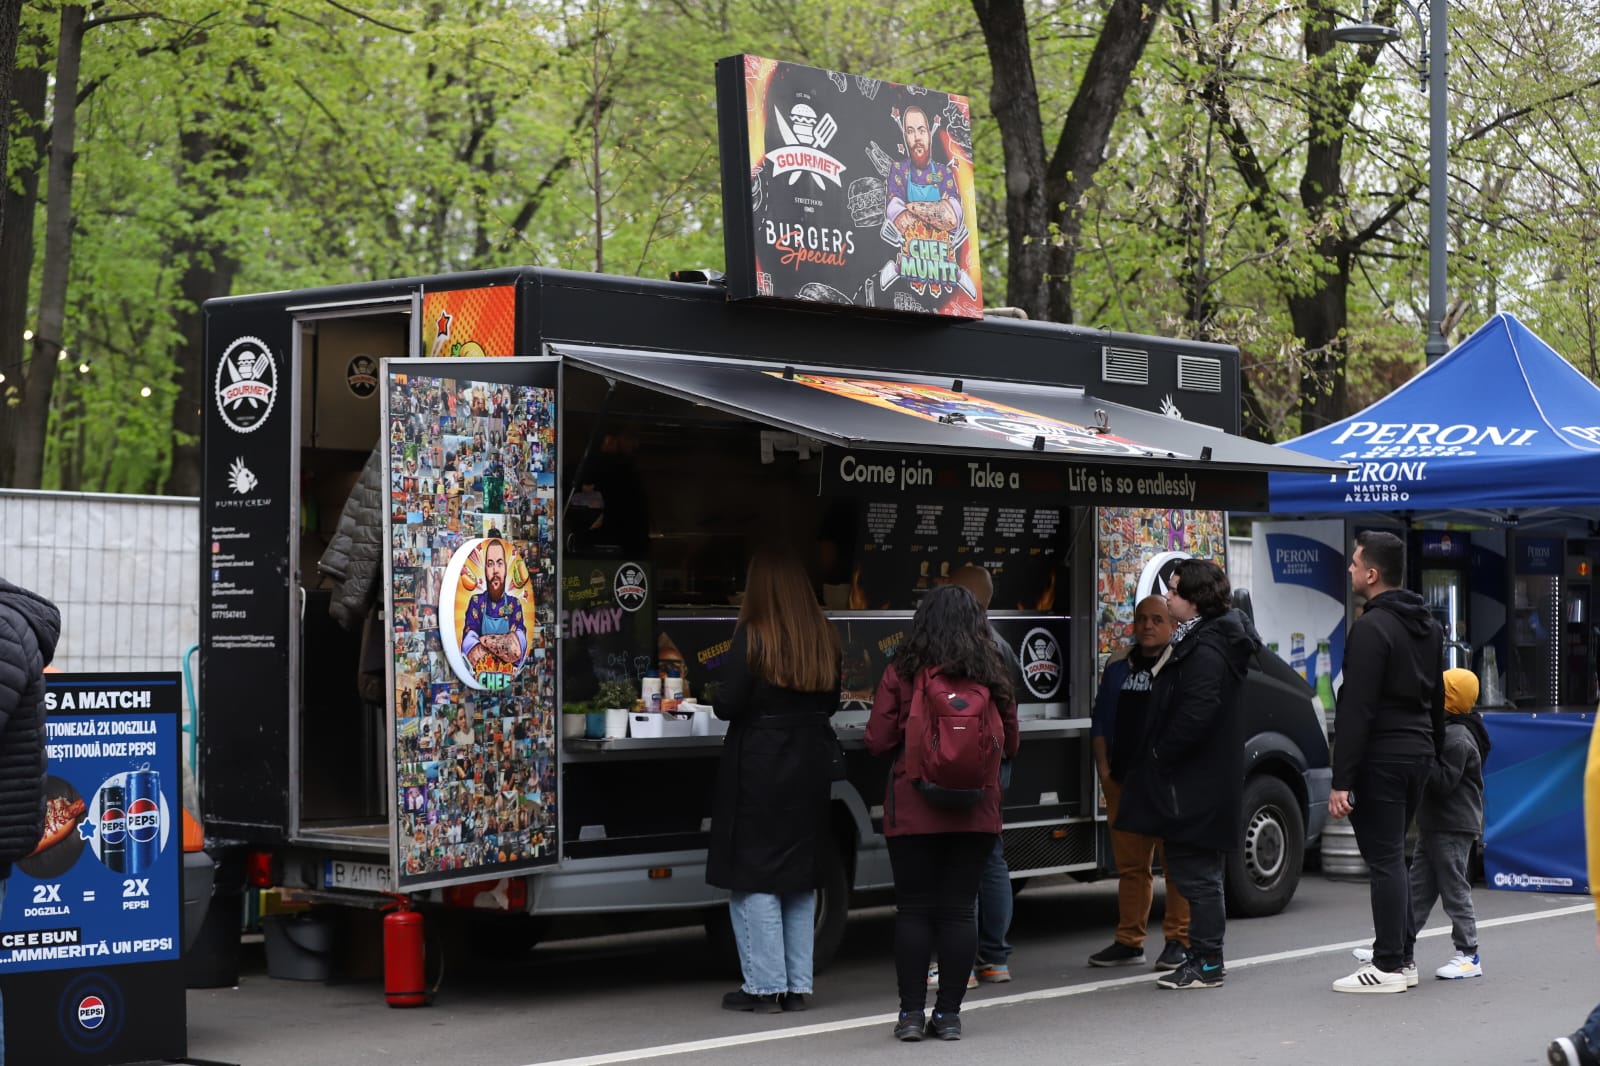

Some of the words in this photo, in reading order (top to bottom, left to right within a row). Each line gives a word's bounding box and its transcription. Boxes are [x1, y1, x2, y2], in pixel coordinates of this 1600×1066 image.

[776, 152, 841, 176] GOURMET
[765, 220, 855, 254] BURGERS
[775, 230, 848, 271] Special
[909, 238, 948, 260] CHEF
[900, 255, 958, 283] MUNTI
[226, 385, 269, 399] GOURMET
[1330, 421, 1540, 446] PERONI
[840, 455, 896, 484] Come
[900, 459, 933, 490] join
[967, 462, 1005, 489] Take
[1009, 471, 1020, 489] a
[1068, 467, 1097, 492] Life
[1100, 469, 1113, 493] is
[1116, 477, 1133, 494] so
[1137, 472, 1197, 502] endlessly
[1353, 484, 1398, 493] NASTRO
[1344, 491, 1410, 503] AZZURRO
[1276, 548, 1319, 563] PERONI
[571, 606, 623, 639] AWAY
[1028, 663, 1057, 673] GOURMET
[60, 692, 76, 710] A
[78, 690, 151, 709] MATCH!
[97, 721, 111, 736] 2X
[111, 720, 157, 735] DOGZILLA
[74, 740, 101, 758] DOUĂ
[102, 742, 127, 757] DOZE
[128, 741, 156, 757] PEPSI
[102, 822, 125, 832] PEPS
[128, 815, 158, 826] PEPSI
[335, 863, 345, 883] B
[32, 884, 62, 903] 2X
[122, 878, 150, 898] 2X
[24, 906, 71, 917] DOGZILLA
[122, 900, 150, 911] PEPSI
[2, 935, 25, 947] CE
[28, 935, 39, 945] E
[41, 930, 78, 944] BUN
[112, 941, 132, 954] UN
[133, 938, 173, 953] PEPSI
[80, 1008, 104, 1017] PEPSI
